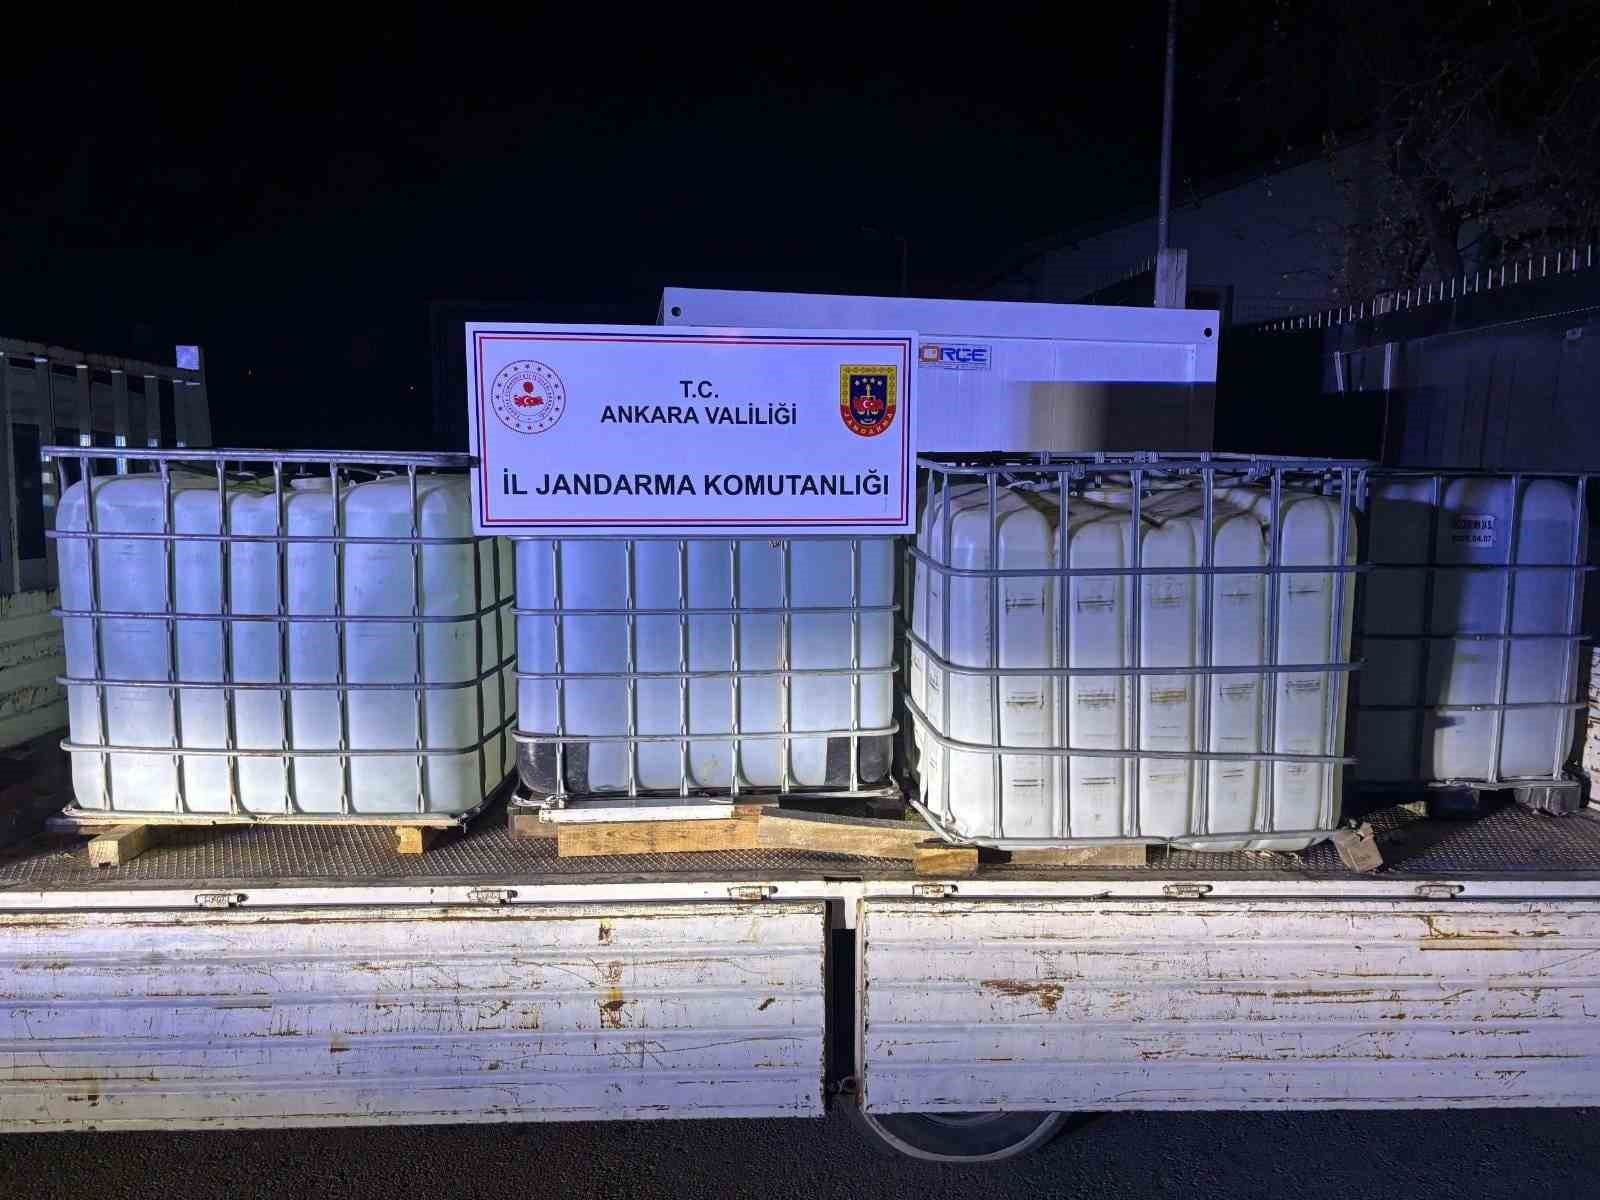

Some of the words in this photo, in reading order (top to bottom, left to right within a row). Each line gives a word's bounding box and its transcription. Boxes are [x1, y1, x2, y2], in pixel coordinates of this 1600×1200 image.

[681, 381, 719, 398] T.C.
[601, 405, 699, 424] ANKARA
[704, 402, 796, 425] VALİLİĞİ
[503, 468, 527, 495] İL
[536, 474, 695, 496] JANDARMA
[704, 469, 889, 496] KOMUTANLIĞI
